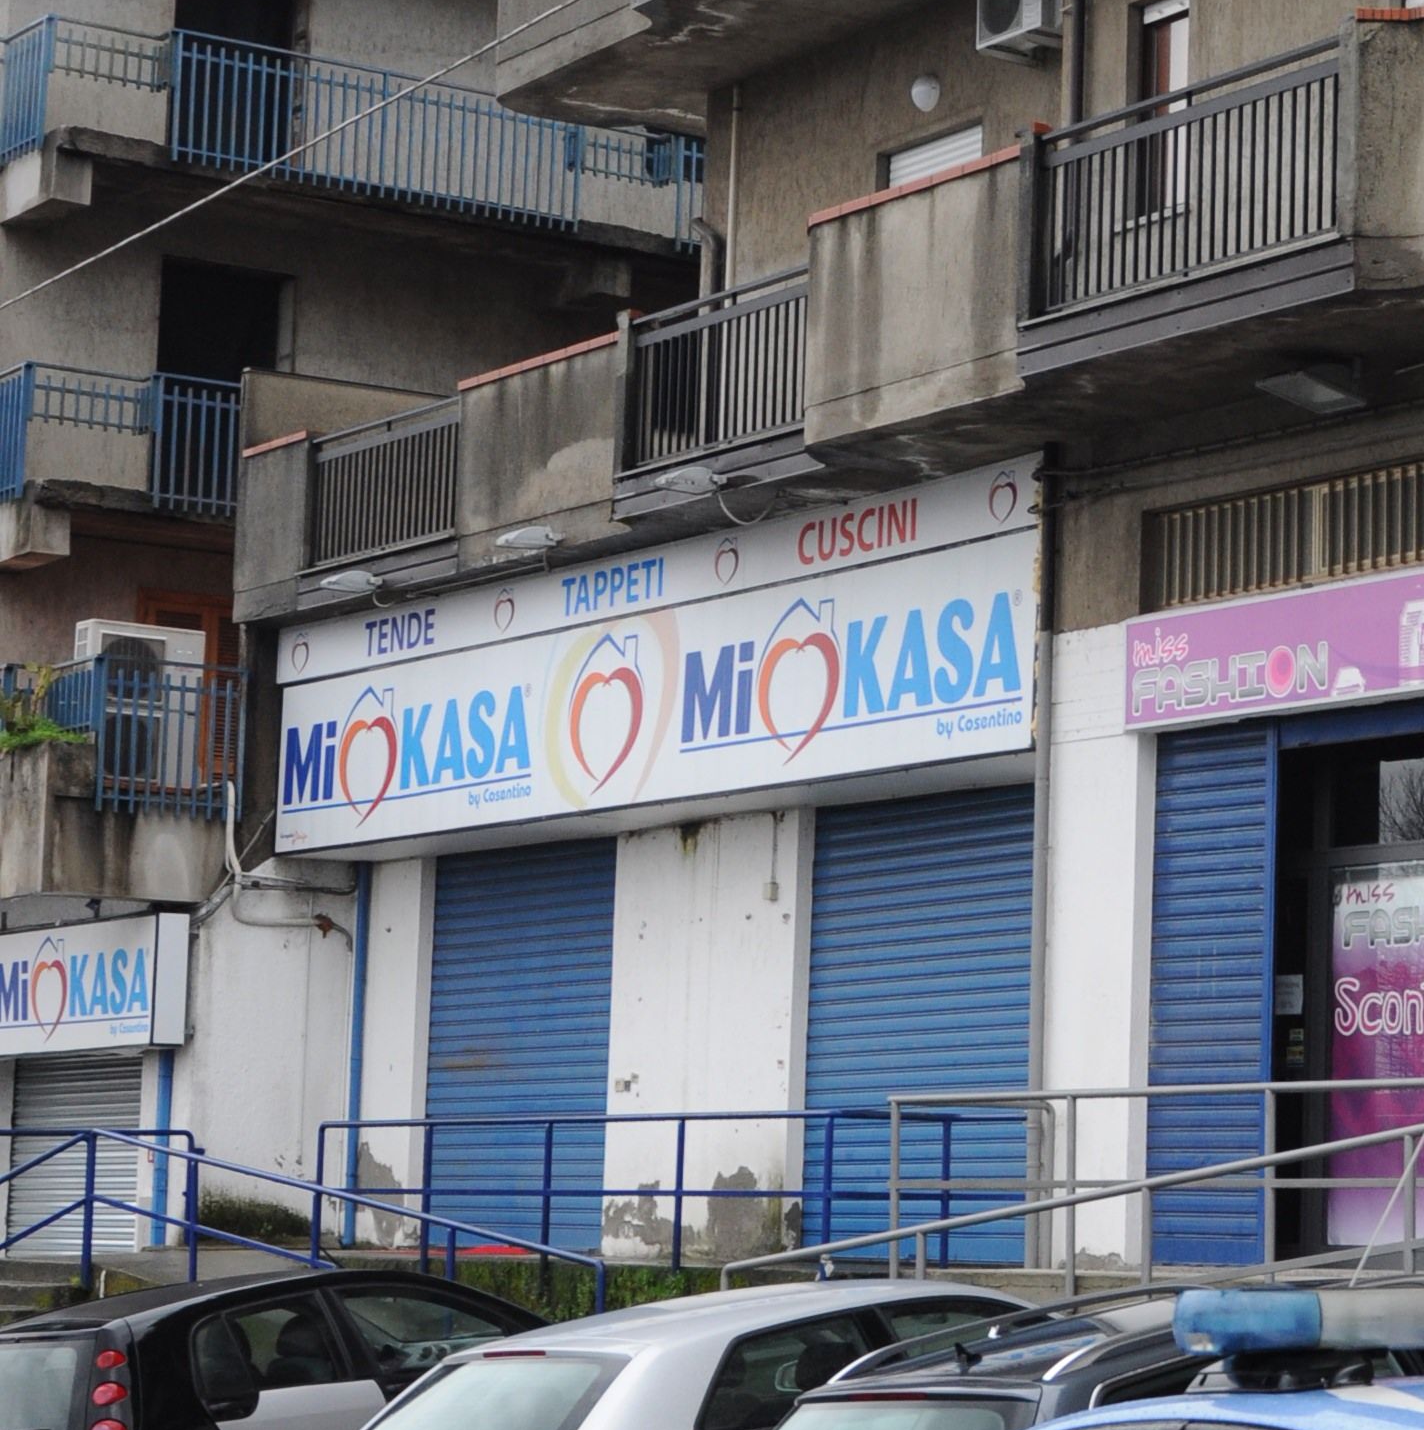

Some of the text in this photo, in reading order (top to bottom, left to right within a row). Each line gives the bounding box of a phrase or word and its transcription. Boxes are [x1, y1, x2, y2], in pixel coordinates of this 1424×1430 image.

[798, 498, 918, 565] CUSCINI
[562, 557, 665, 617] TAPPETI
[365, 608, 436, 657] TENDE
[1133, 627, 1188, 666] miss
[1132, 641, 1328, 716] FASHION
[936, 708, 1023, 739] by Cosentino
[468, 790, 480, 810] by
[1345, 882, 1396, 904] miss
